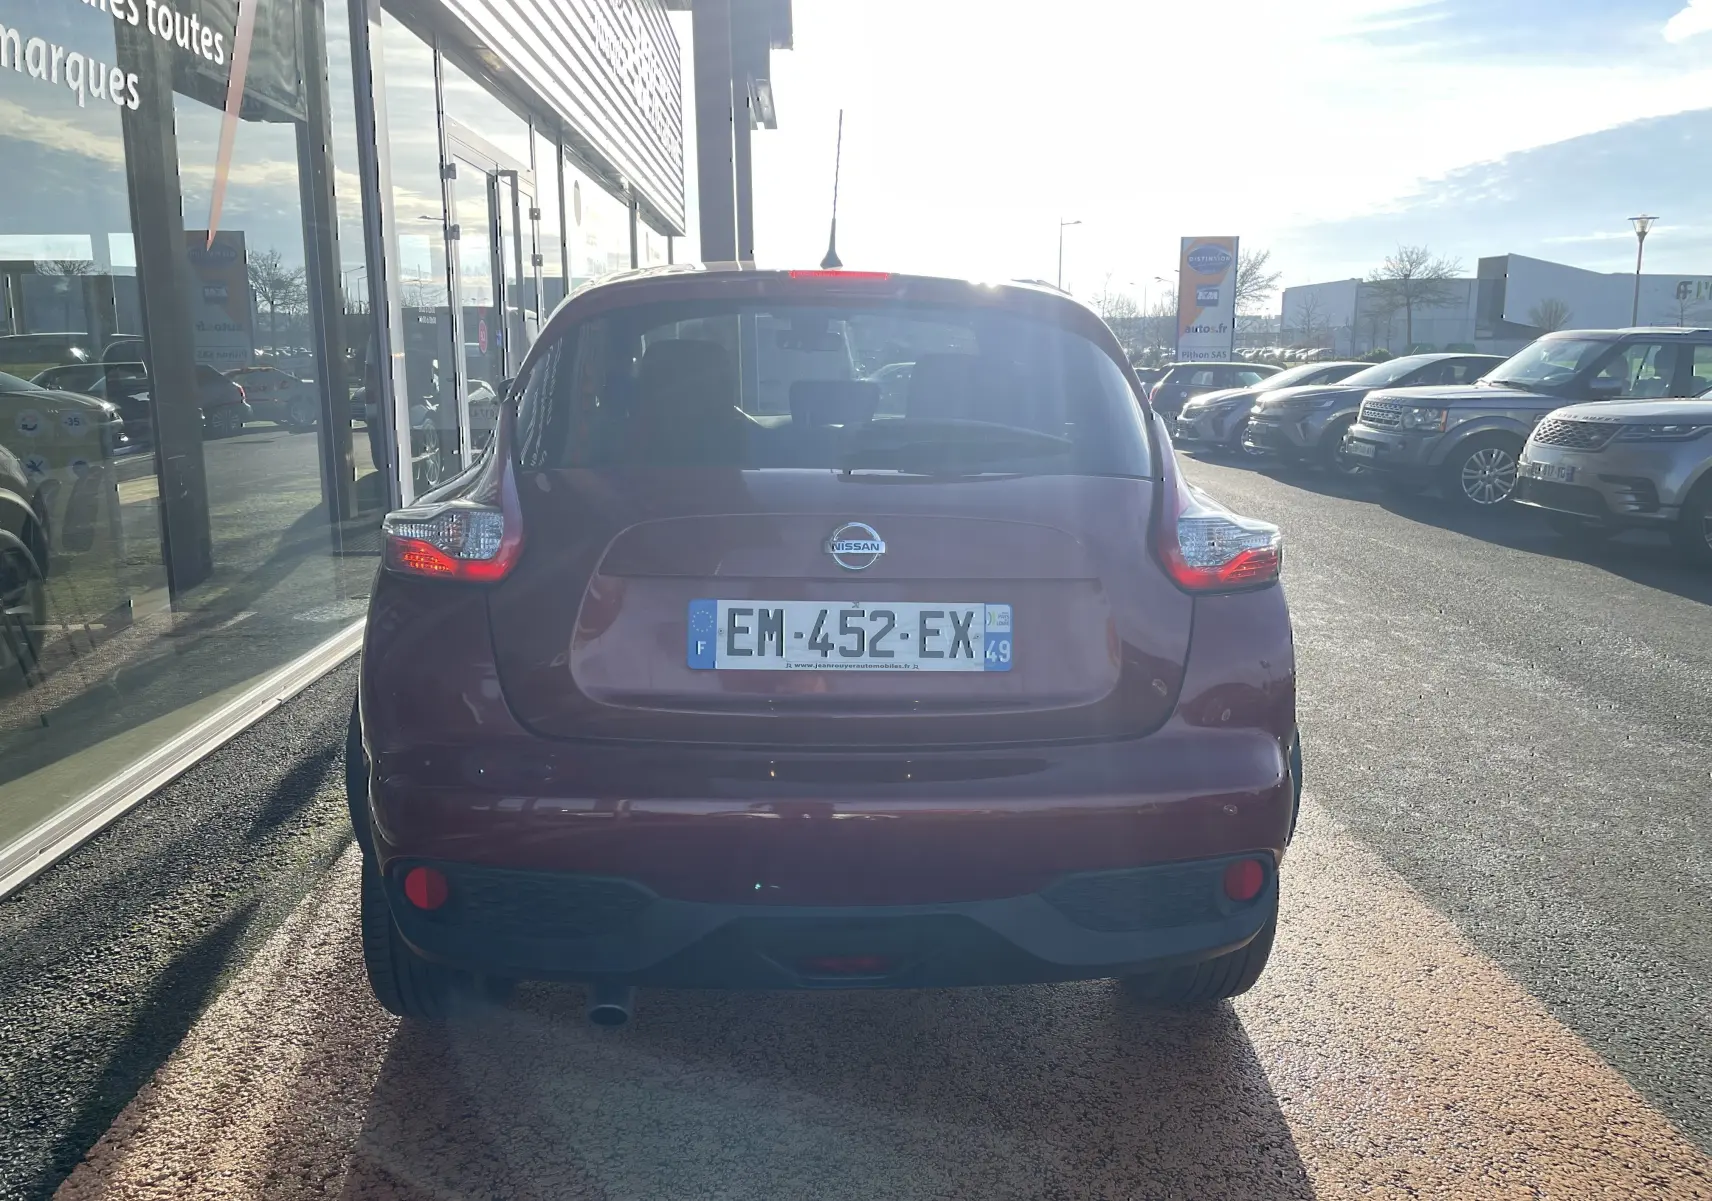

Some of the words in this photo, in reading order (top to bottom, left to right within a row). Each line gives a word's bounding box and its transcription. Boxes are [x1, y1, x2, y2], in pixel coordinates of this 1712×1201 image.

[147, 0, 224, 65] toutes
[0, 23, 140, 110] marques
[1211, 350, 1227, 359] SAS
[832, 542, 880, 552] NISSAN
[696, 641, 707, 655] F
[986, 640, 1011, 663] 49
